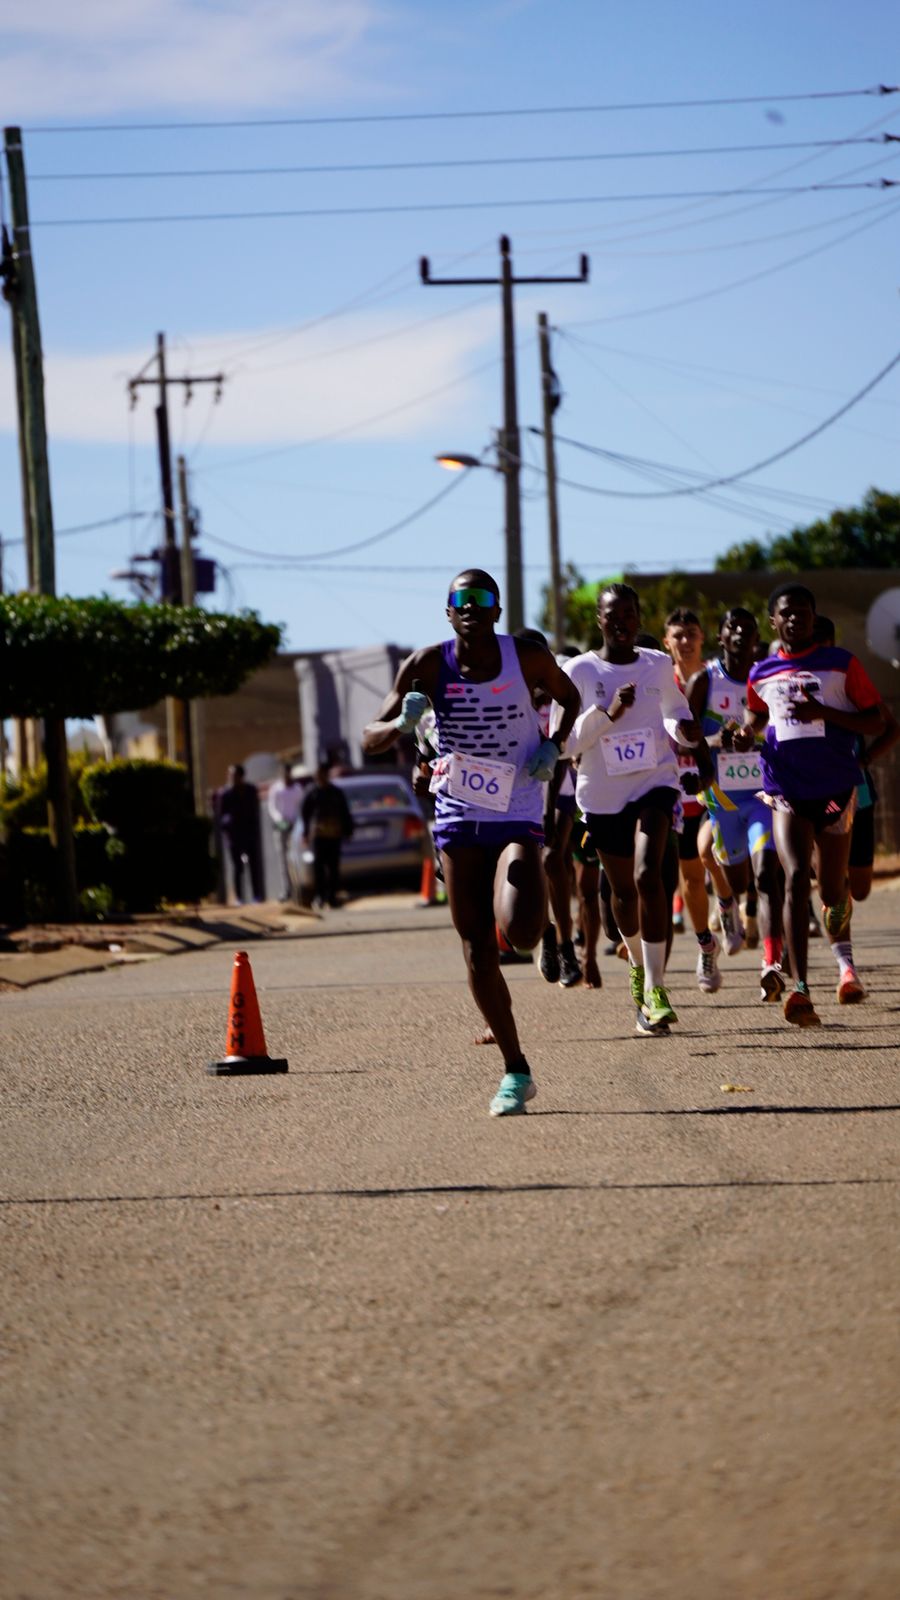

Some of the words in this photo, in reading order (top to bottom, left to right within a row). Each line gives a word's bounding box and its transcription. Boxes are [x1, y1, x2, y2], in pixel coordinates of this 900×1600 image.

[719, 696, 731, 710] J
[614, 741, 646, 763] 167
[725, 764, 761, 779] 406
[461, 769, 500, 795] 106
